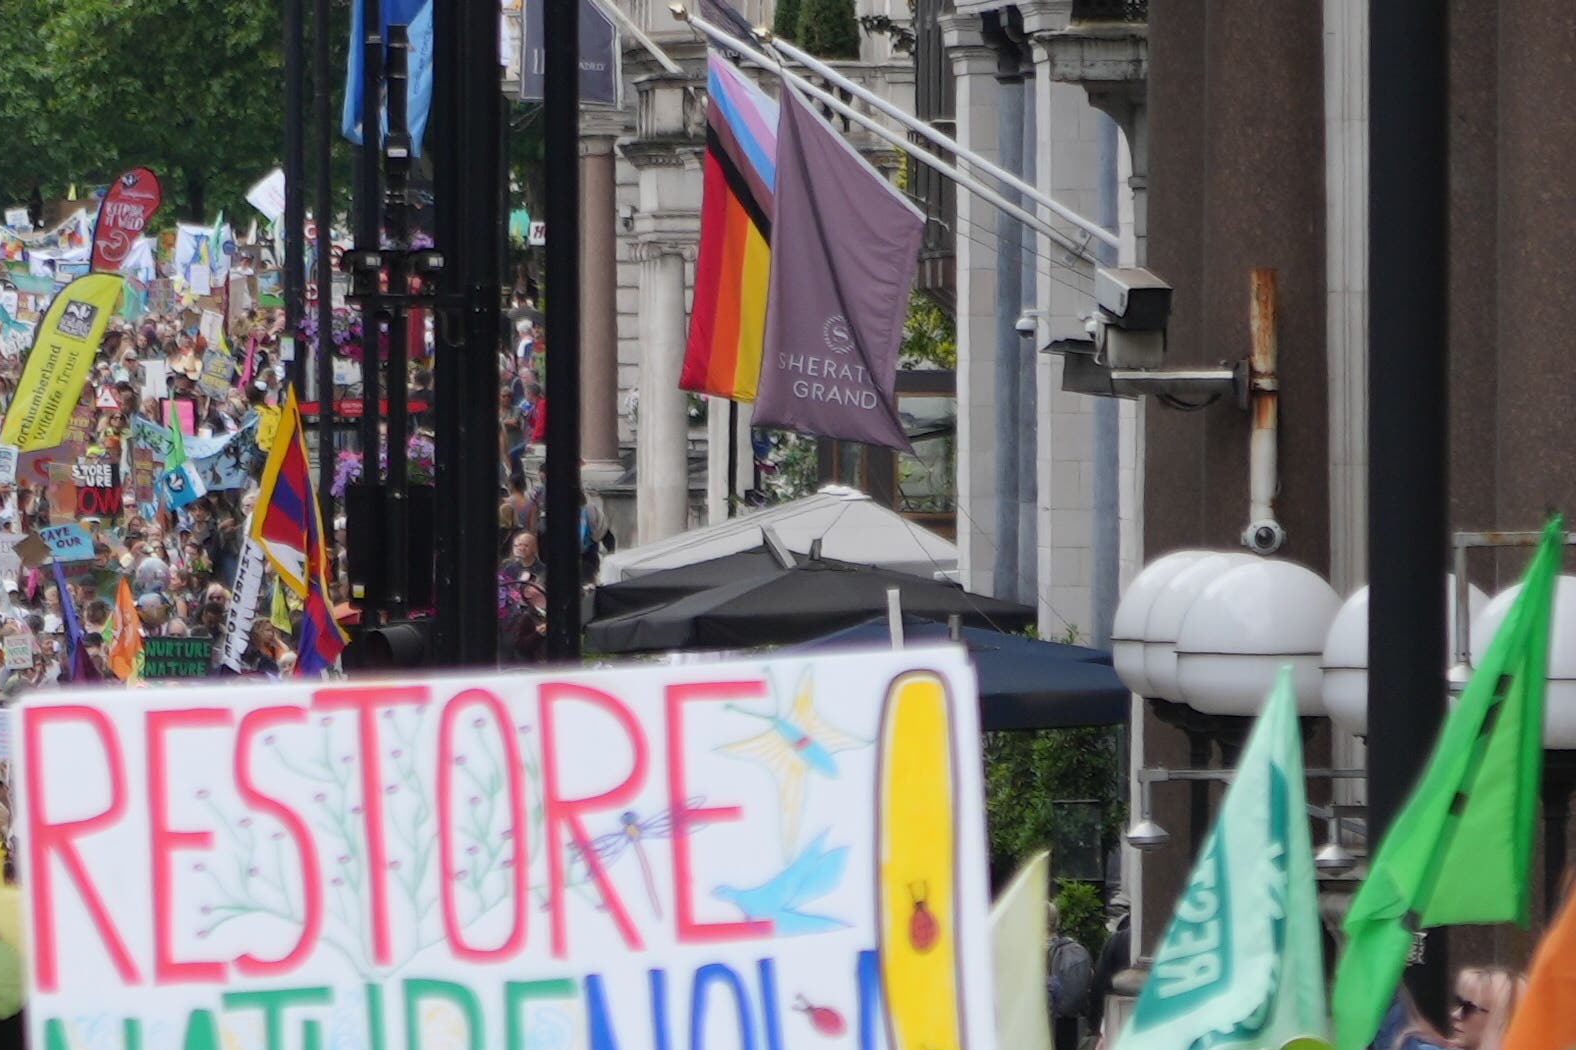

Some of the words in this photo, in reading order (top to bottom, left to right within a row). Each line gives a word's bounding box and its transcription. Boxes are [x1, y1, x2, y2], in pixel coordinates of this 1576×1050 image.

[778, 351, 874, 386] SHERAT
[33, 388, 64, 442] Wildlife
[56, 351, 80, 385] Trust
[793, 380, 878, 410] GRAND
[72, 464, 112, 478] STORE
[86, 475, 113, 488] URE
[77, 488, 122, 515] OW
[40, 526, 71, 543] SAVE
[56, 538, 82, 549] OUR
[233, 543, 253, 603] THIRD
[145, 639, 211, 658] NURTURE
[224, 611, 238, 659] POLE
[145, 660, 207, 677] NATURE
[24, 679, 773, 992] RESTORE
